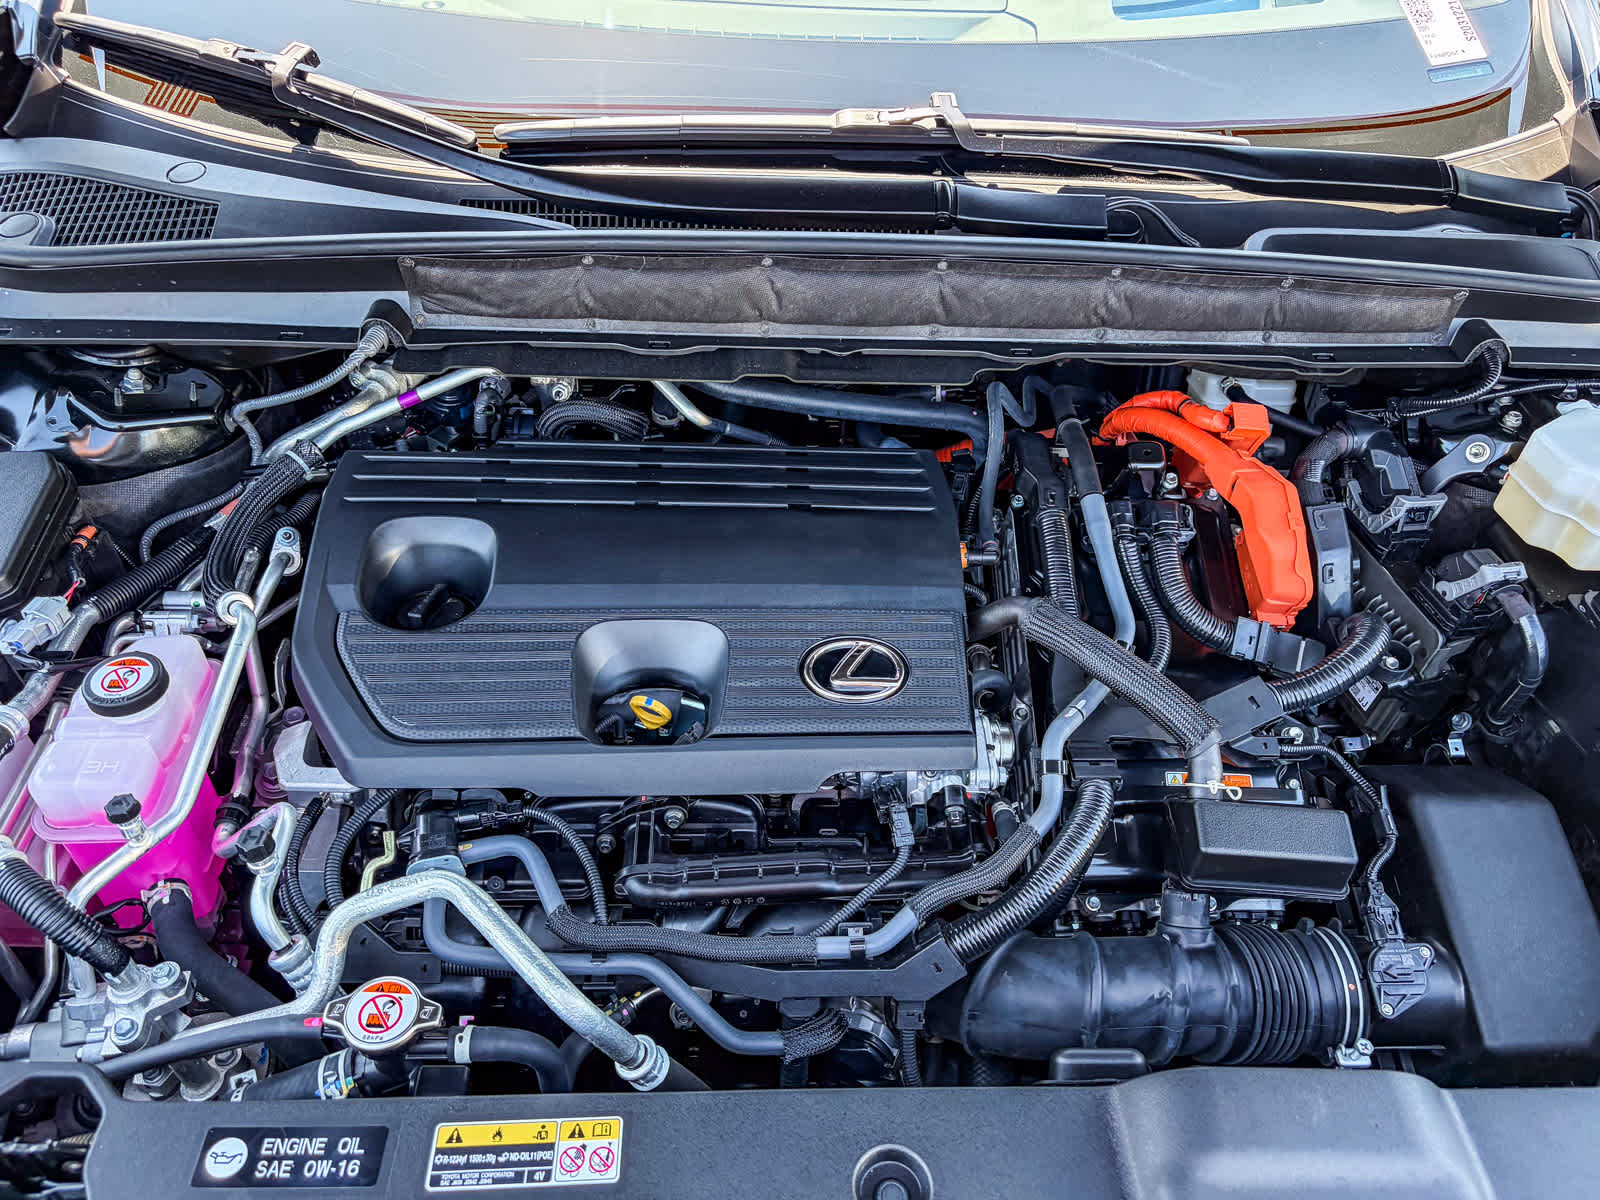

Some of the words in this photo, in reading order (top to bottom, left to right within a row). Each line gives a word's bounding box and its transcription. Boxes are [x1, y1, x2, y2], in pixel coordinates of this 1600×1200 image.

[262, 1137, 328, 1155] ENGINE
[337, 1137, 365, 1154] OIL
[254, 1160, 294, 1178] SAE
[303, 1159, 361, 1177] 0W-16
[534, 1171, 545, 1181] 4V
